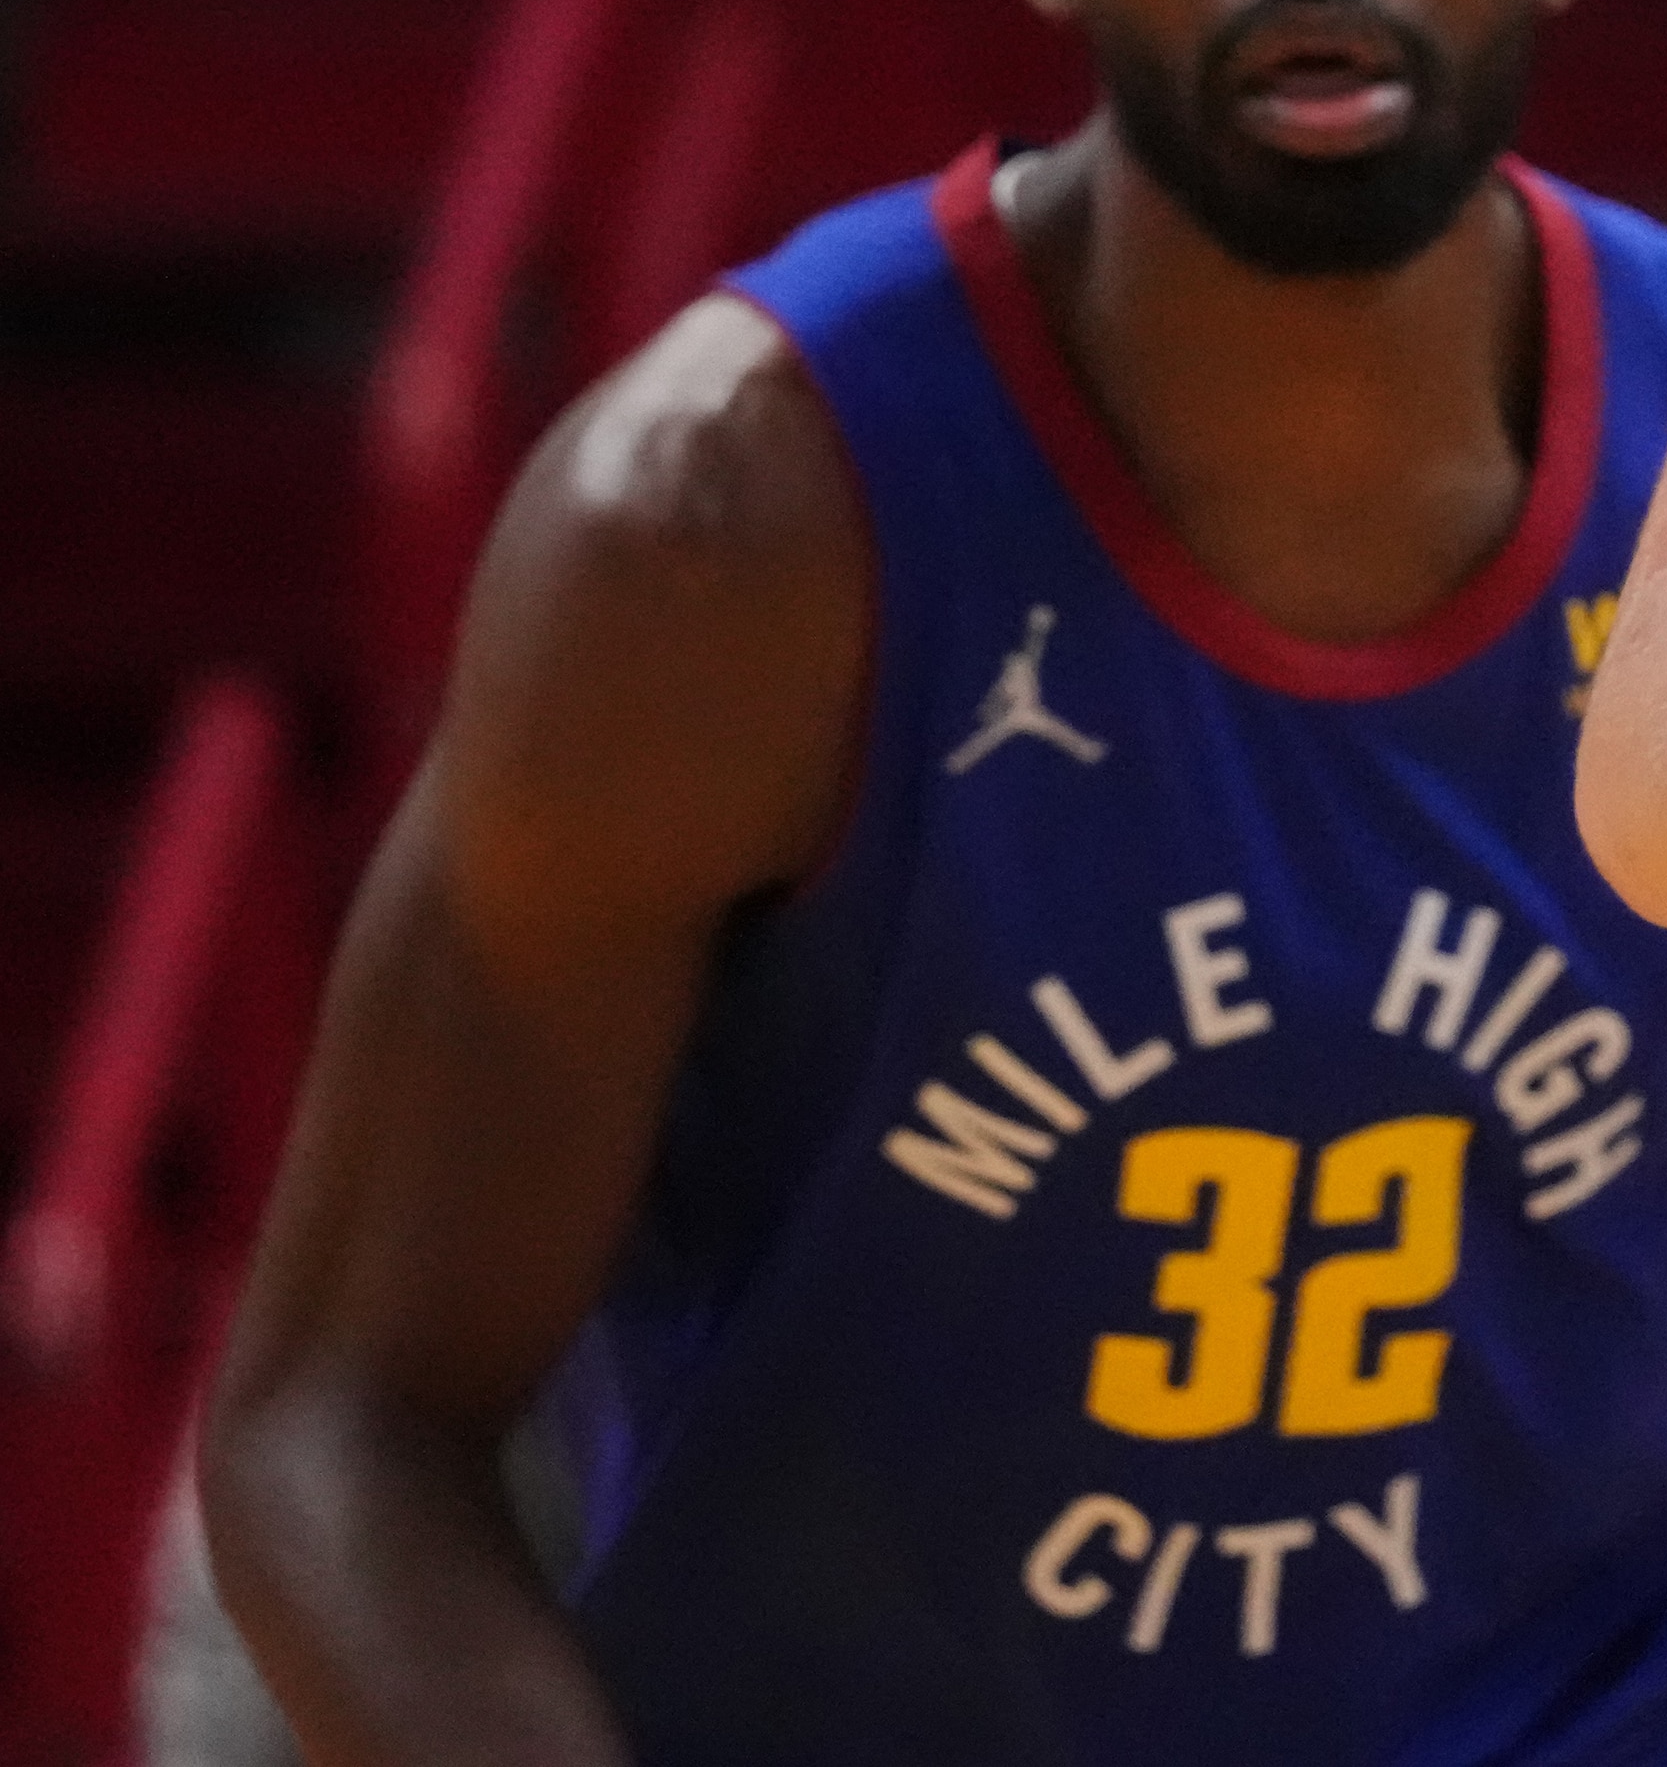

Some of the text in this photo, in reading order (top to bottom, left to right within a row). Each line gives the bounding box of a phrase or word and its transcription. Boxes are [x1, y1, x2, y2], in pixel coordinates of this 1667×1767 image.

[882, 888, 1646, 1220] MILE HIGH
[1083, 1115, 1474, 1440] 32
[1023, 1473, 1425, 1657] CITY
